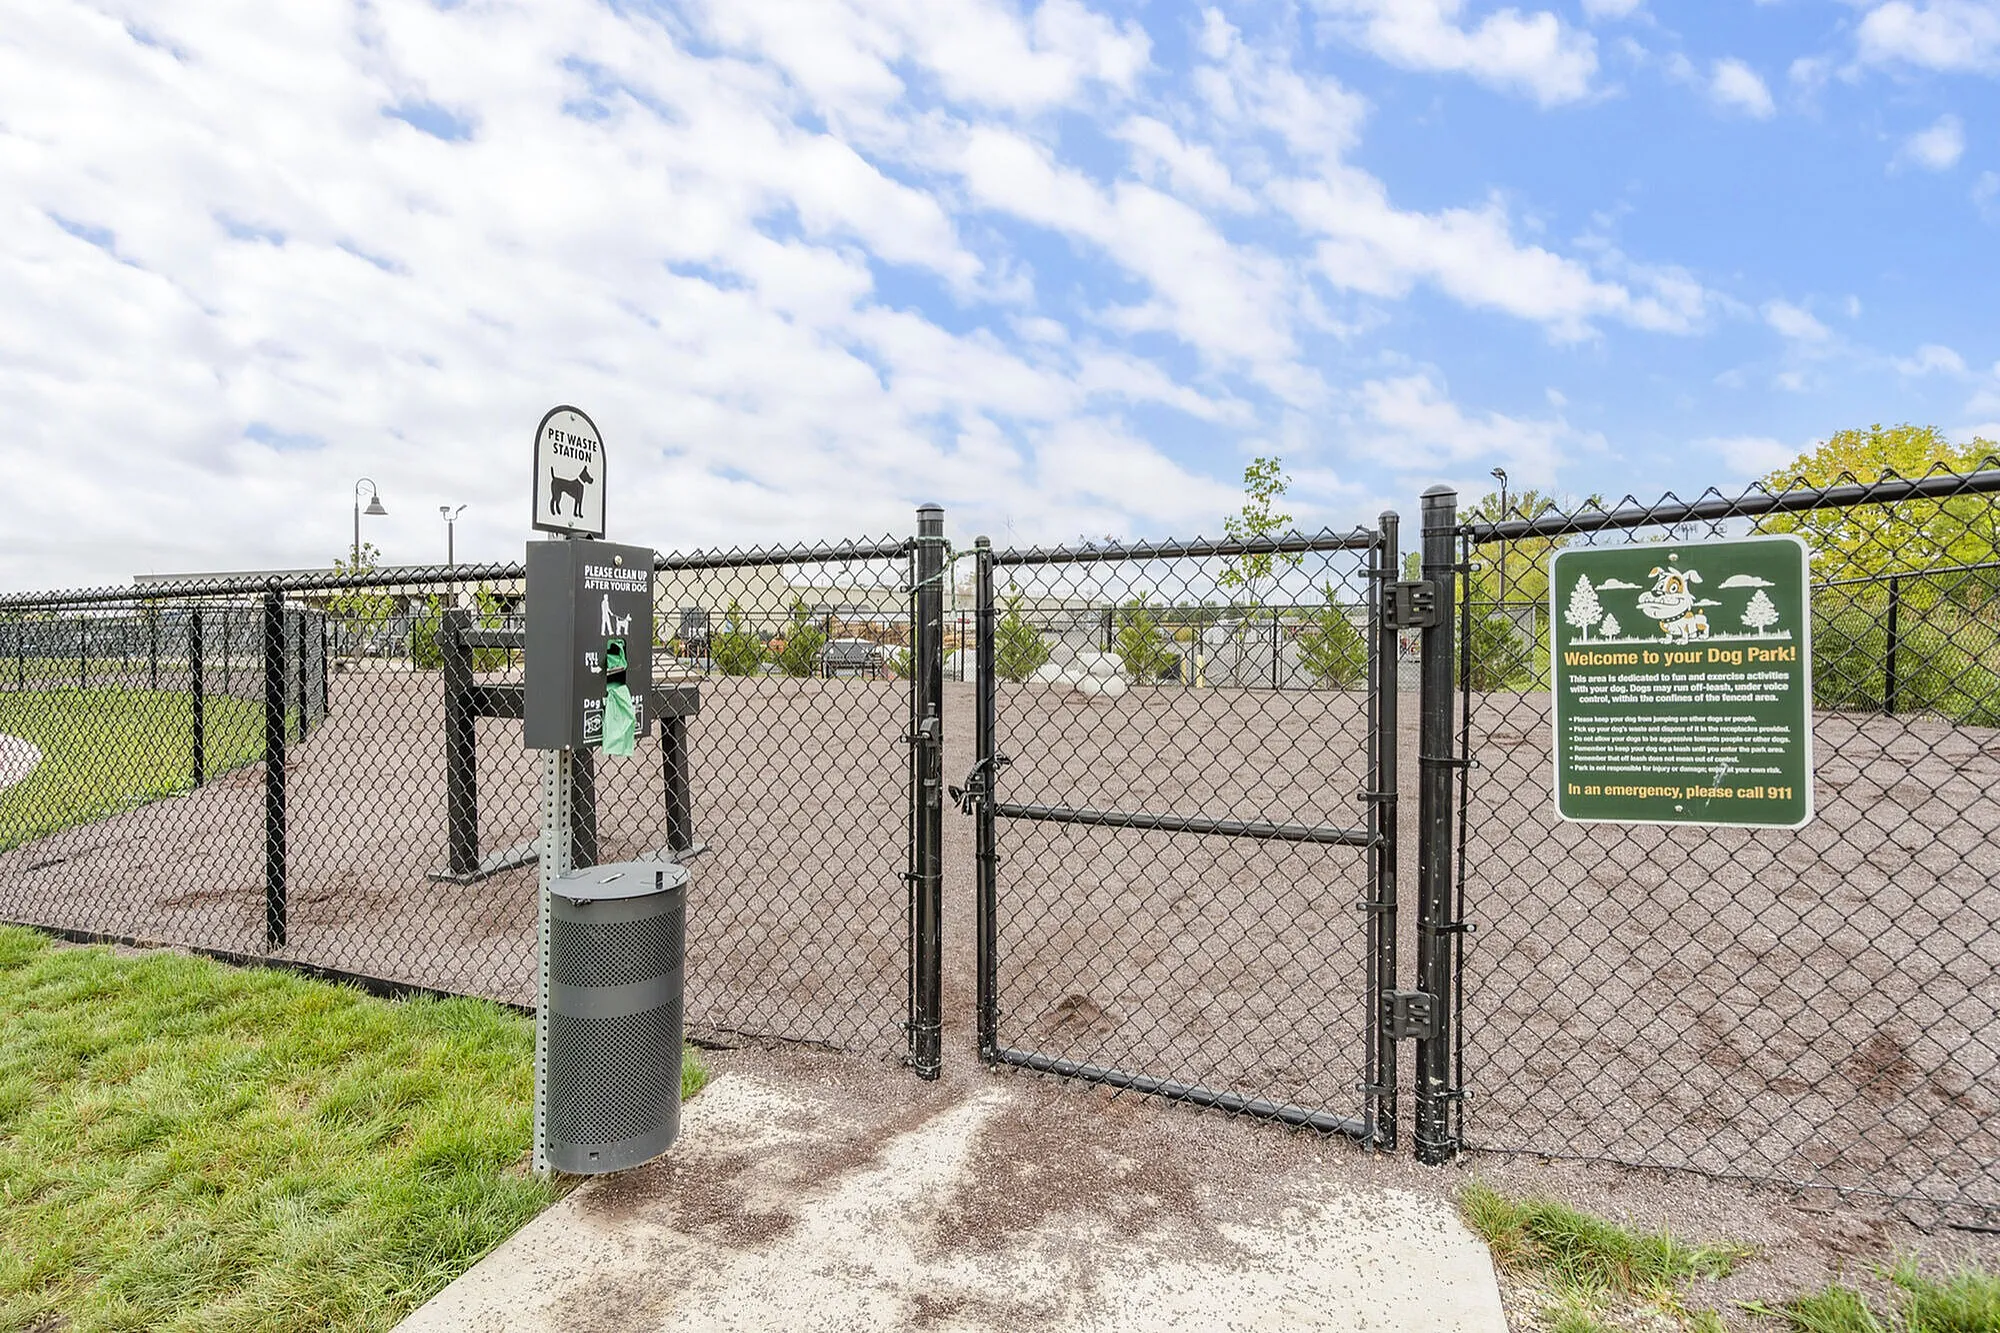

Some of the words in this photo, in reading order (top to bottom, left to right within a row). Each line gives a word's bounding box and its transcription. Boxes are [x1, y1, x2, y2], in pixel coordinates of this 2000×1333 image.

[548, 428, 565, 443] PET
[567, 434, 597, 452] WASTE
[553, 443, 592, 463] STATION
[585, 565, 613, 578] PLEASE
[614, 568, 637, 580] CLEAN
[637, 570, 648, 581] UP
[584, 580, 610, 590] AFTER
[610, 582, 631, 592] YOUR
[631, 583, 648, 593] DOG
[1564, 651, 1639, 666] Welcome
[1642, 650, 1659, 664] to
[1663, 651, 1703, 667] your
[1707, 648, 1743, 665] Dog
[1747, 646, 1796, 662] Park!
[1569, 675, 1587, 683] This
[1608, 674, 1616, 682] is
[1617, 674, 1660, 682] dedicated
[1661, 673, 1671, 681] to
[1672, 673, 1687, 681] fun
[1688, 673, 1705, 681] and
[1707, 672, 1745, 680] exercise
[1746, 671, 1790, 680] activities
[1570, 685, 1588, 693] with
[1589, 686, 1608, 694] your
[1610, 685, 1629, 694] dog.
[1629, 684, 1652, 693] Dogs
[1653, 685, 1672, 693] may
[1690, 683, 1734, 692] off-leash,
[1734, 682, 1762, 691] under
[1763, 682, 1789, 690] voice
[583, 698, 601, 709] Dog
[1579, 695, 1610, 704] control,
[1612, 694, 1639, 703] within
[1639, 694, 1654, 702] the
[1655, 694, 1693, 702] confines
[1694, 693, 1704, 702] of
[1705, 693, 1720, 702] the
[1722, 693, 1753, 702] fenced
[1706, 715, 1723, 723] dogs
[1732, 715, 1757, 723] people.
[1661, 725, 1685, 733] dispose
[1614, 745, 1630, 753] keep
[1750, 746, 1767, 754] park
[1568, 783, 1581, 795] In
[1584, 786, 1601, 796] an
[1604, 785, 1683, 799] emergency,
[1686, 785, 1733, 799] please
[1737, 786, 1763, 799] call
[1768, 787, 1792, 799] 911
